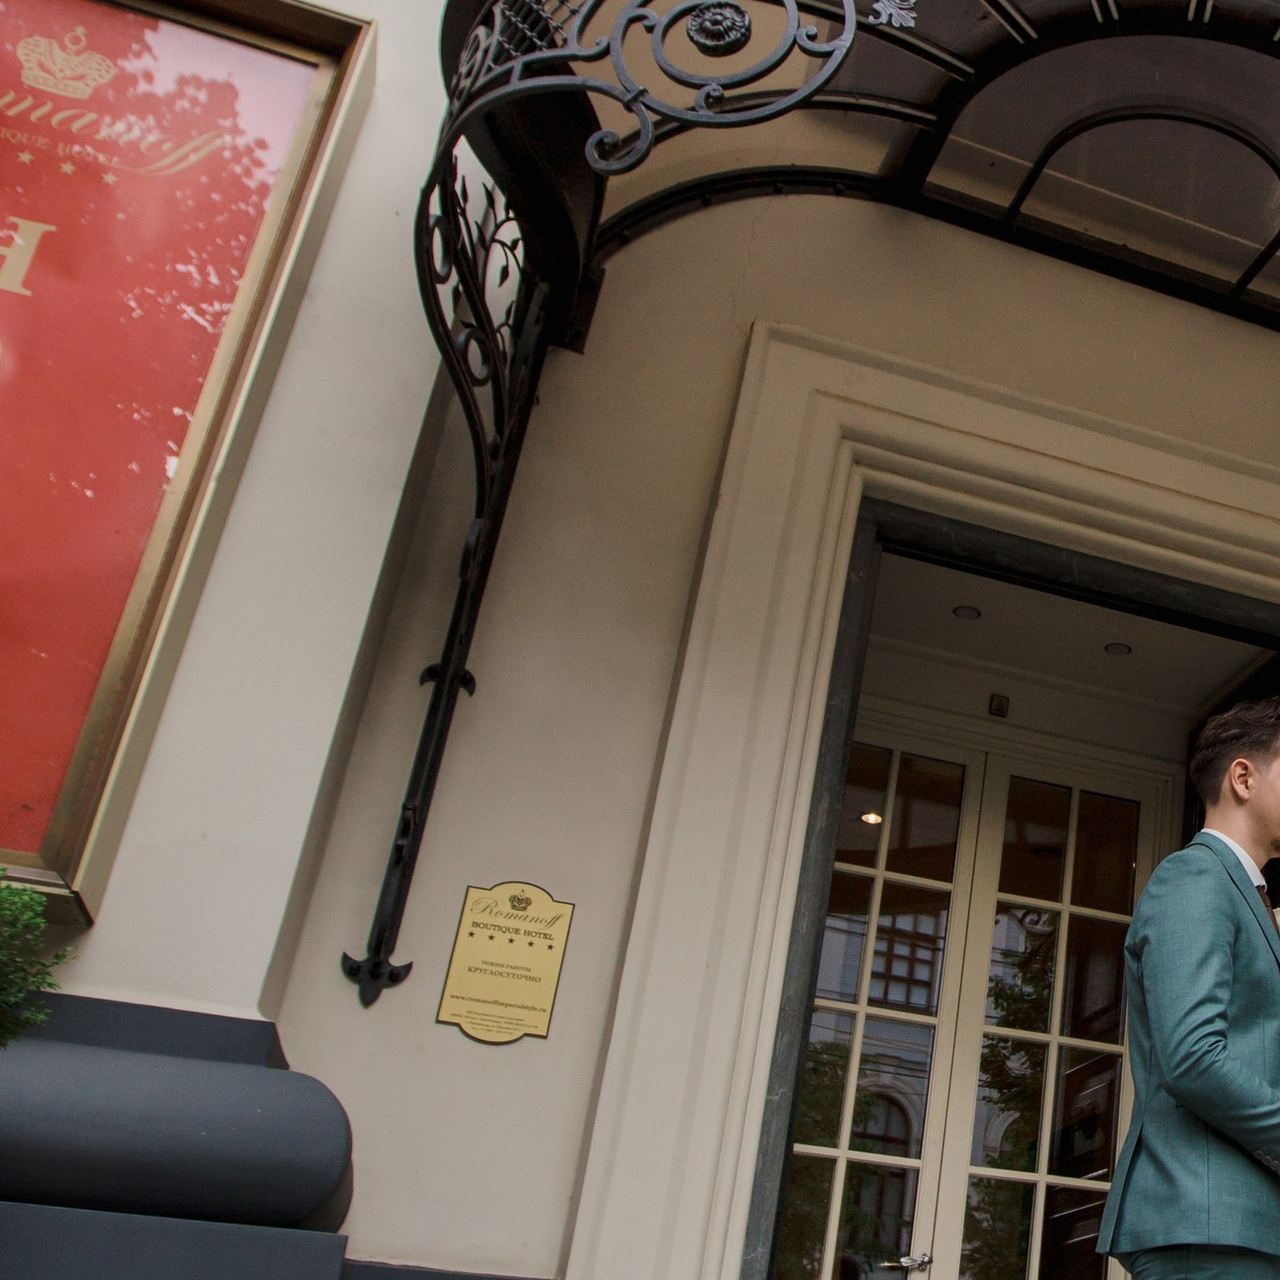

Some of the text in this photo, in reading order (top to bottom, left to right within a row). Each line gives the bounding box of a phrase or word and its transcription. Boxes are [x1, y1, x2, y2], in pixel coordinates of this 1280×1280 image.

[470, 897, 565, 930] Romanoff
[471, 920, 554, 941] BOUTIQUE HOTEL
[467, 965, 541, 984] КРУГЛОСУТОЧНО
